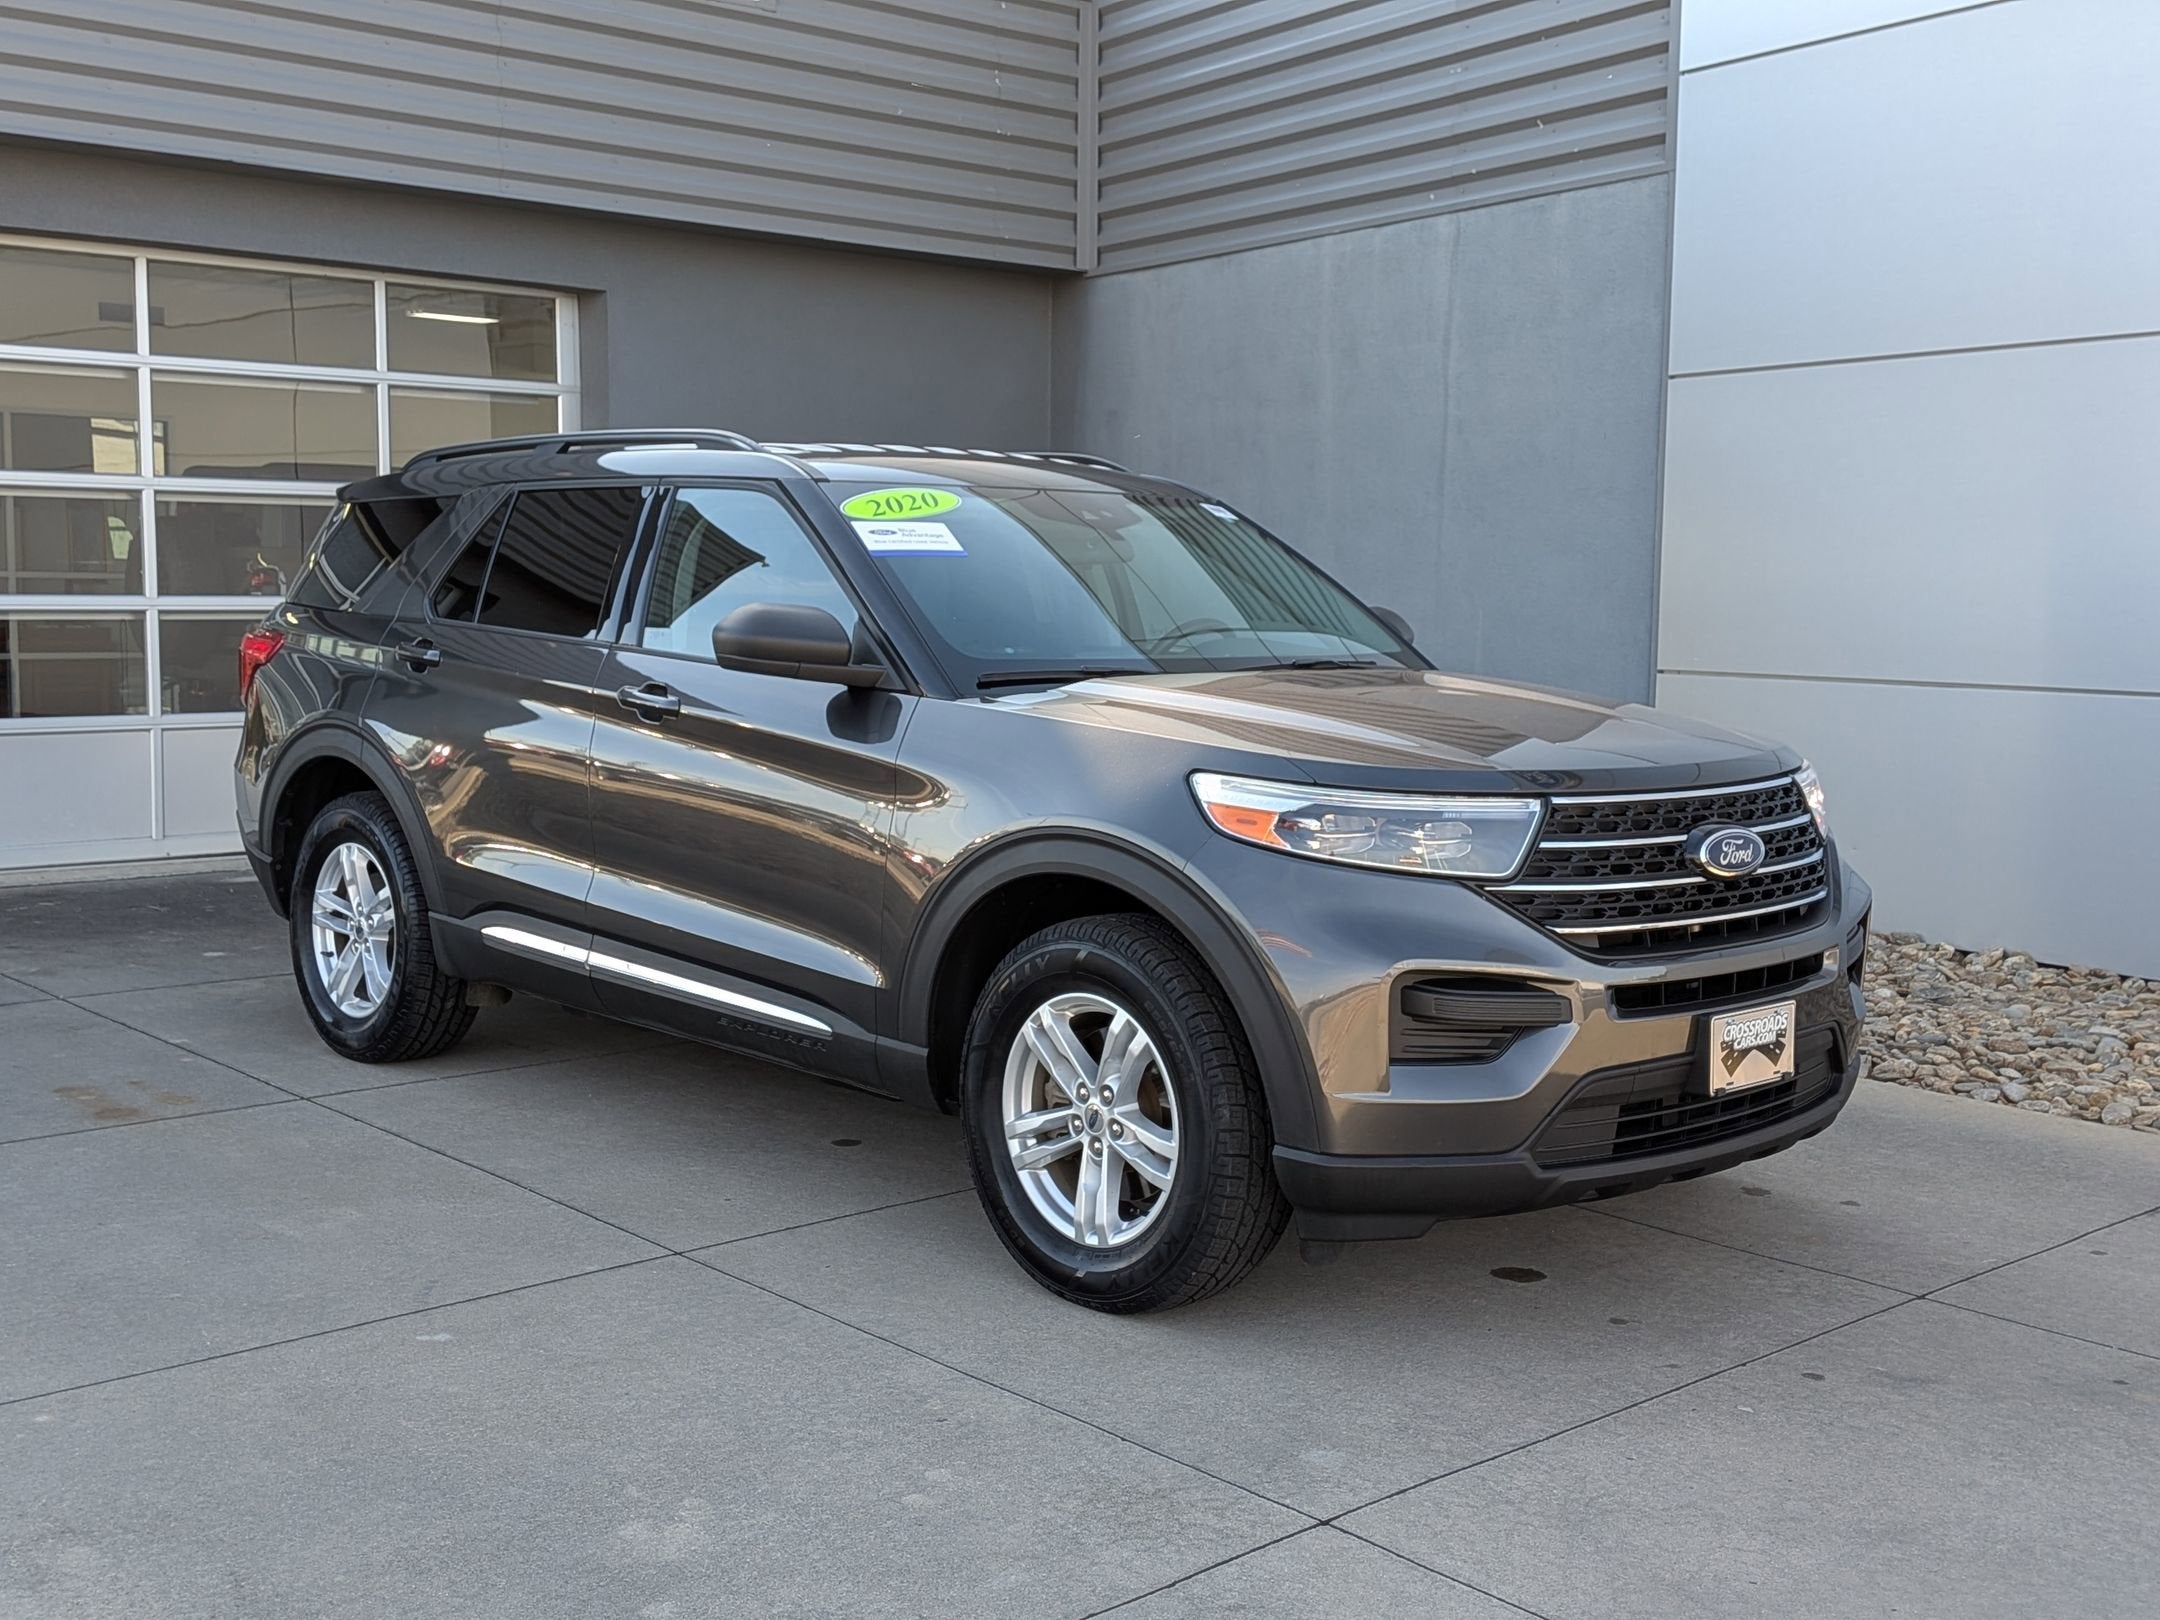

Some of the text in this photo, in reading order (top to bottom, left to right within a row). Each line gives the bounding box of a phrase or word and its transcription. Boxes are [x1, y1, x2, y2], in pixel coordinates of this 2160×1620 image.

[866, 492, 938, 517] 2020
[1720, 838, 1754, 865] Ford
[1723, 1013, 1788, 1042] CROSSROADS
[1733, 1030, 1777, 1051] CARS.COM
